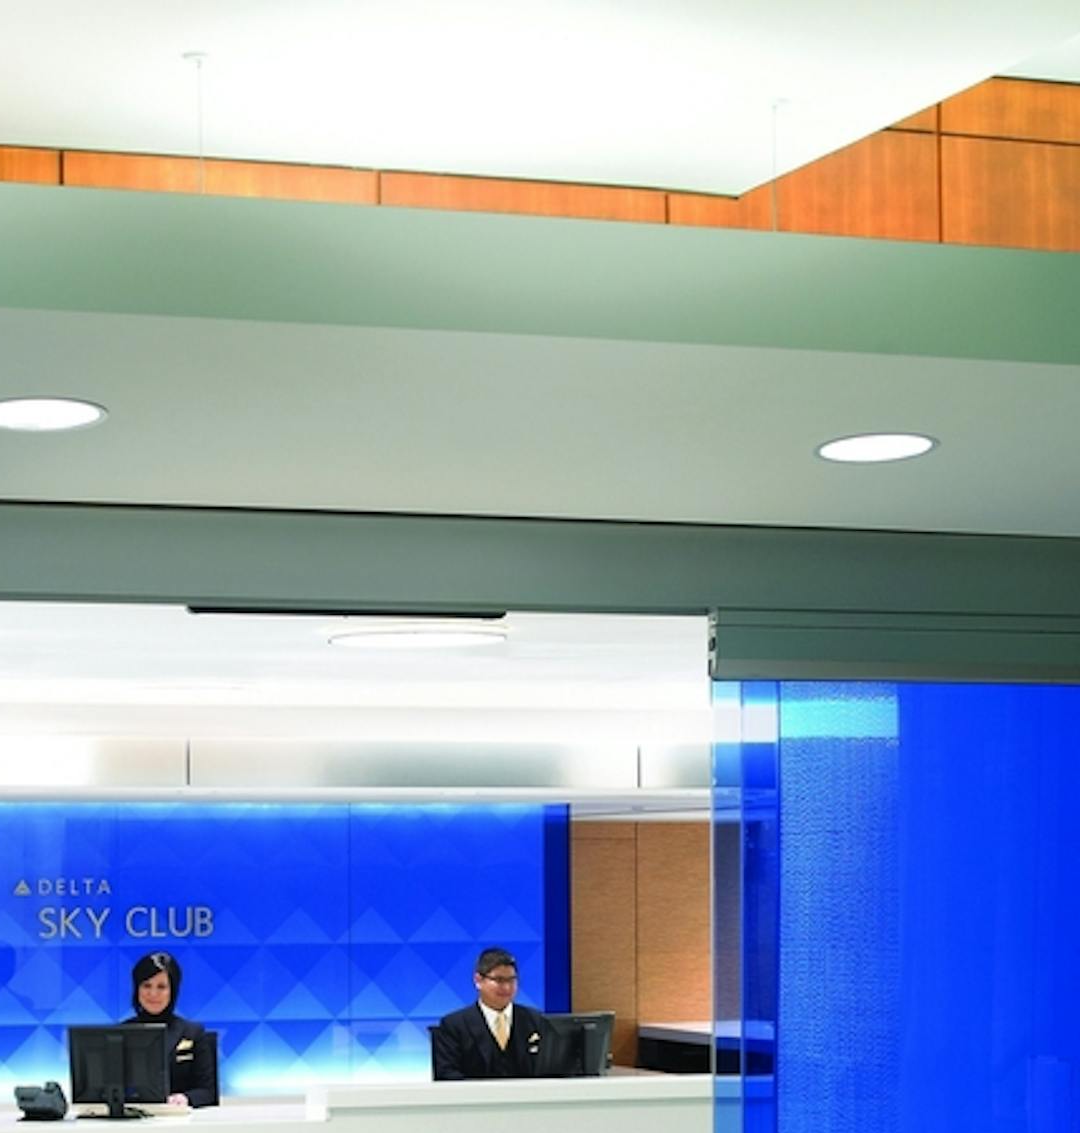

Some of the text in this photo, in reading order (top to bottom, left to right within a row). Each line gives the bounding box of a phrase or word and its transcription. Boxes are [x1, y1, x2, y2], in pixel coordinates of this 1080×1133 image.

[38, 878, 112, 896] DELTA
[38, 906, 214, 938] SKY CLUB
